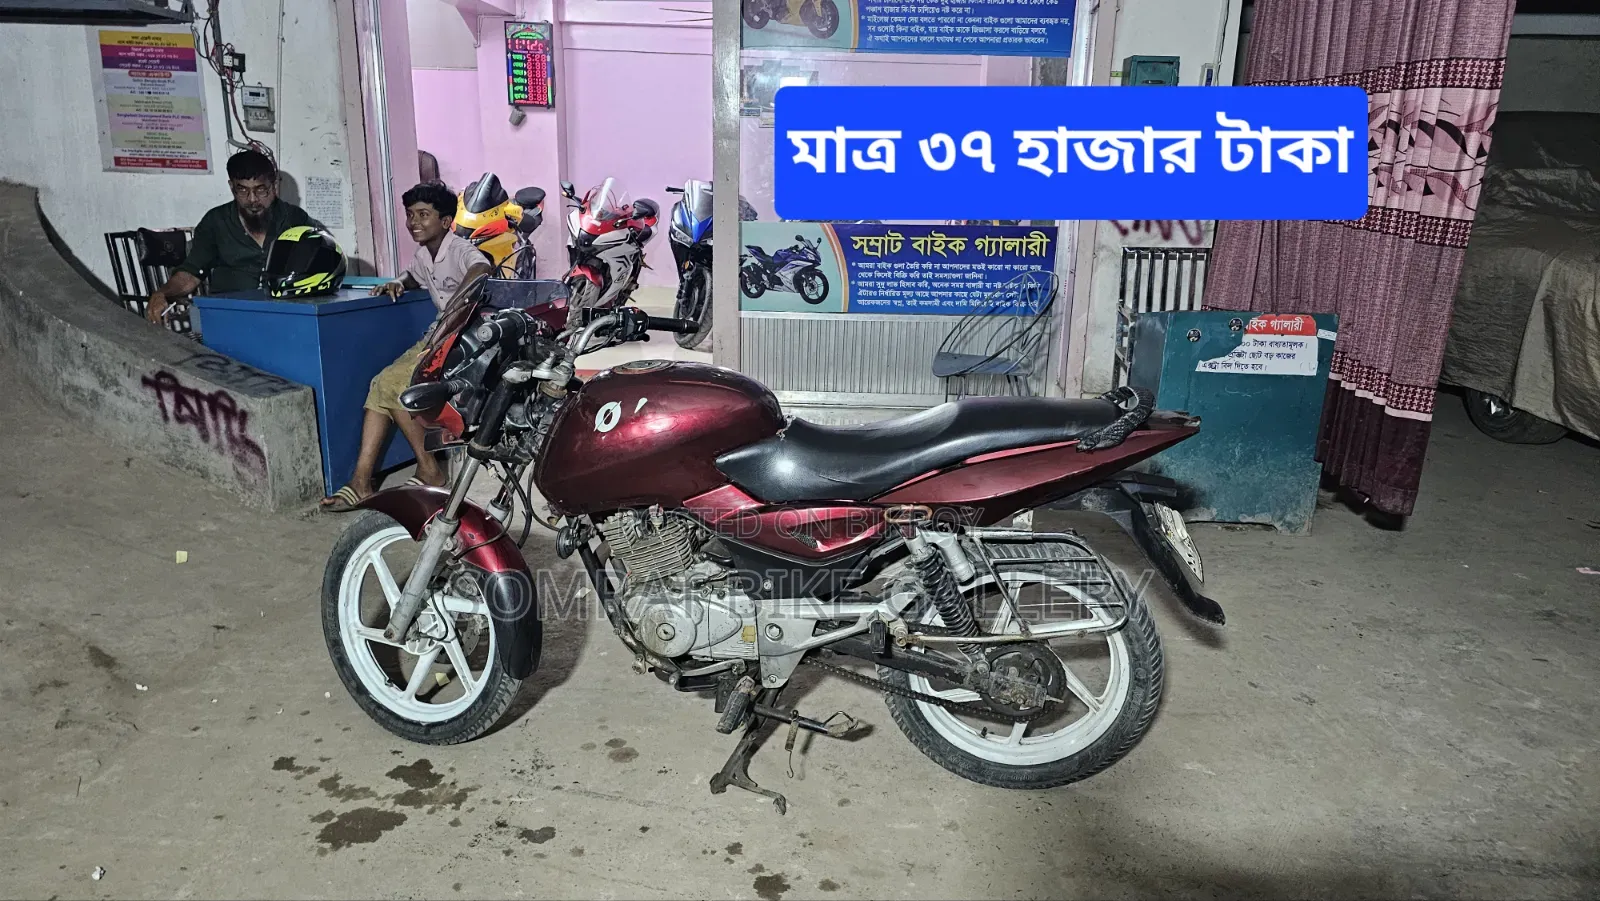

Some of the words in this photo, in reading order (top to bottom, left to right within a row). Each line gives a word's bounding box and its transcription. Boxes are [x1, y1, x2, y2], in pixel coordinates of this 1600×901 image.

[983, 16, 998, 24] বাইক
[940, 26, 954, 34] বাইক
[850, 230, 905, 258] সম্রাট
[910, 231, 968, 258] বাইক
[975, 230, 1050, 258] গ্যালারী
[1270, 317, 1304, 331] গ্যালারী
